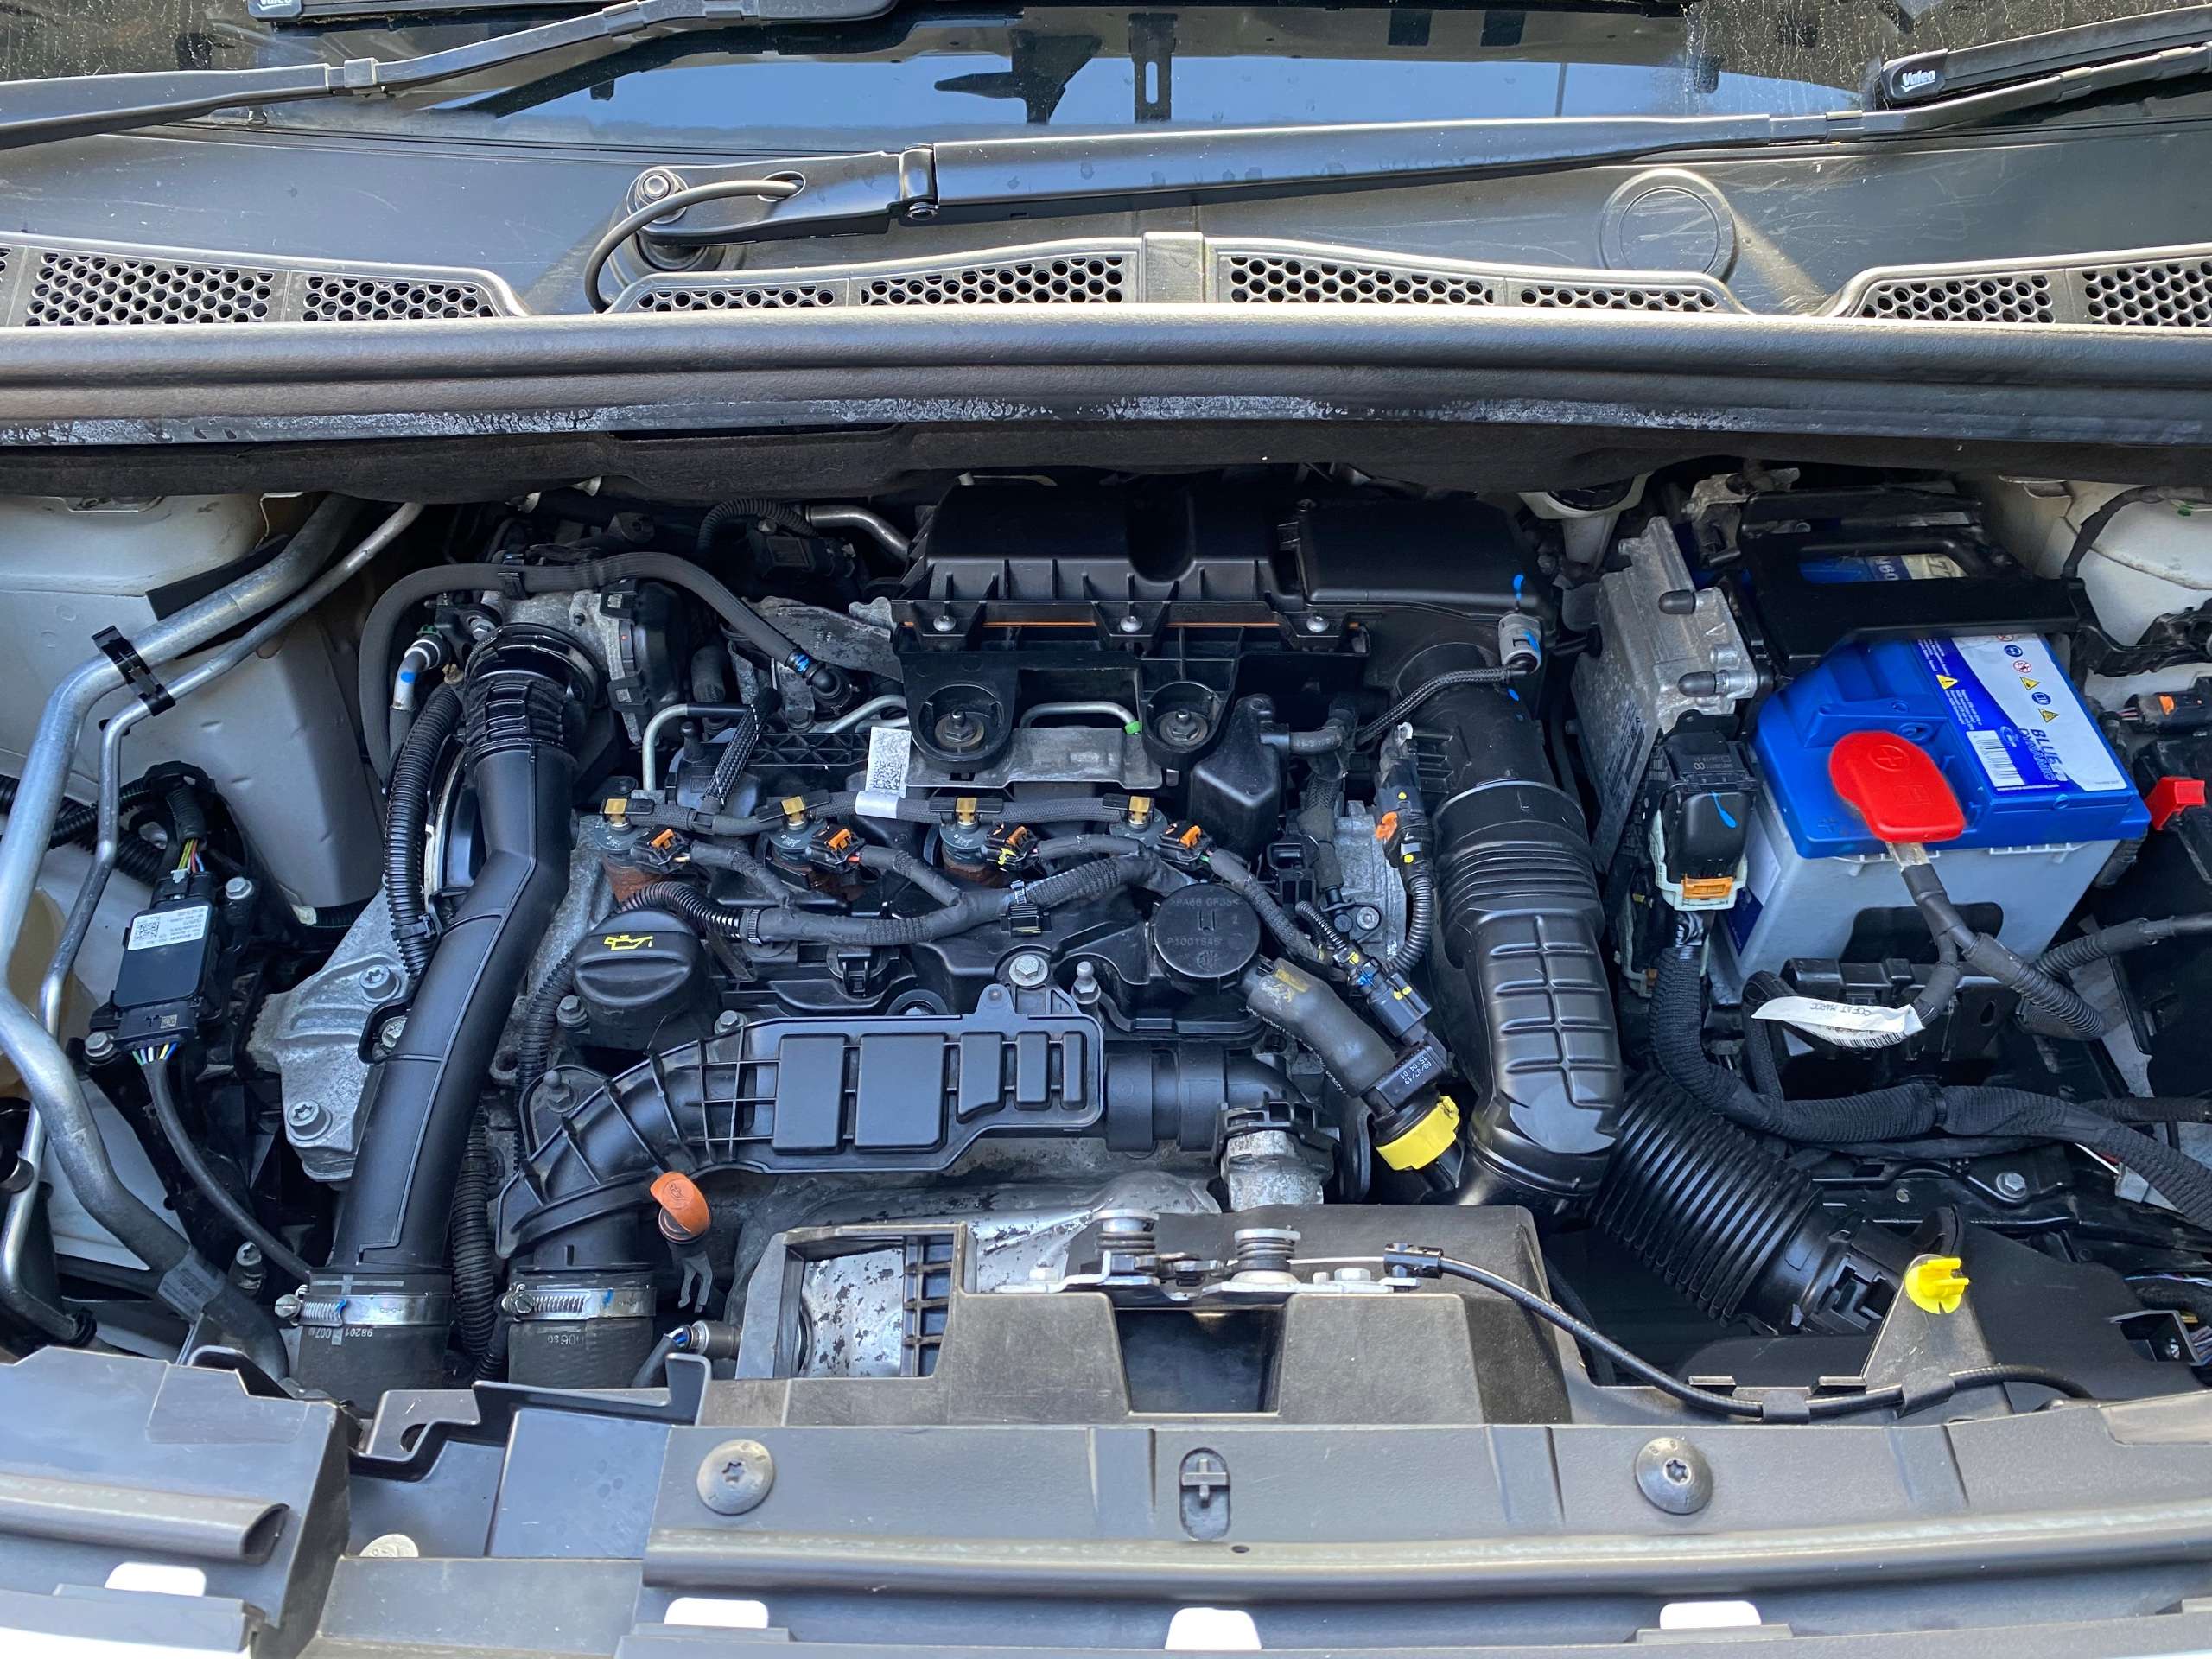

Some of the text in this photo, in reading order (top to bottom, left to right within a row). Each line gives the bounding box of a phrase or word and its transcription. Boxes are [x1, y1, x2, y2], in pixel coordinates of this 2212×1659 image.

[1902, 69, 1936, 86] Valeo
[2030, 728, 2063, 765] BLUE
[1404, 1061, 1433, 1085] 03/07/19
[345, 1328, 374, 1338] 98201
